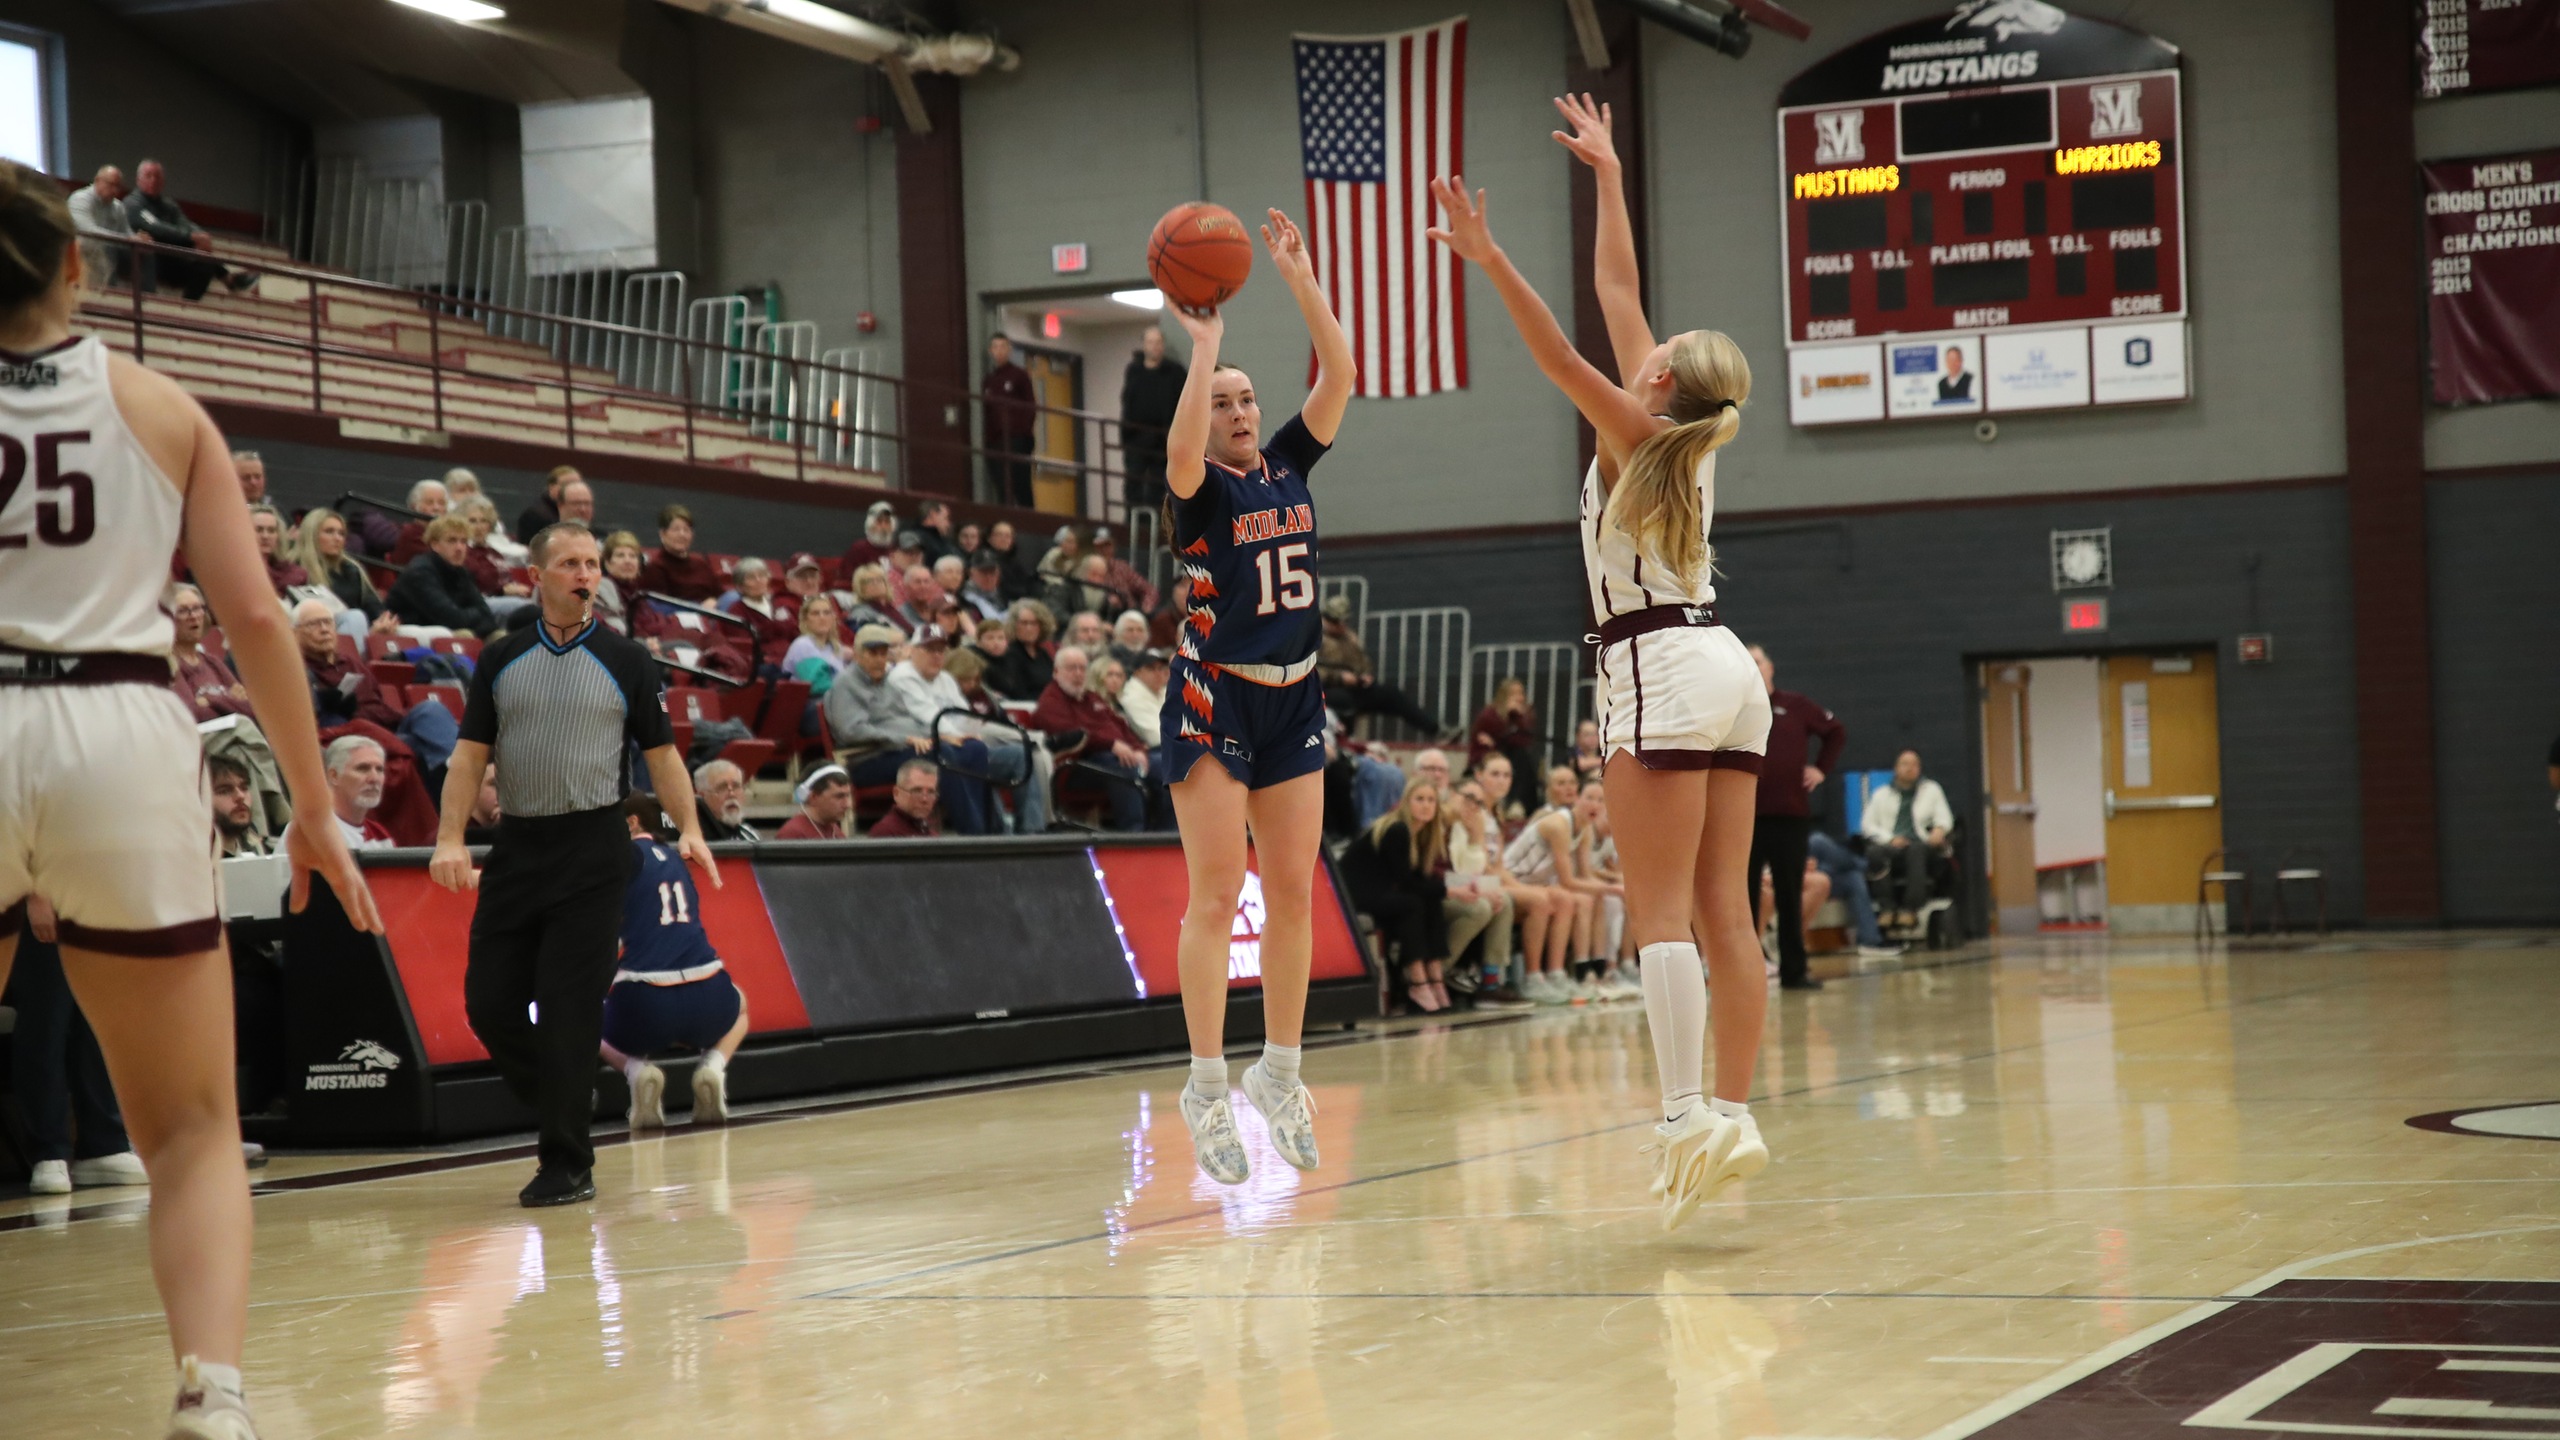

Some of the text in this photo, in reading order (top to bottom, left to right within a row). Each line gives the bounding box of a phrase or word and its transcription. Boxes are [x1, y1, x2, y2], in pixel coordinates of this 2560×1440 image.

[1889, 37, 1988, 60] MORNINGSIDE
[1881, 50, 2039, 91] MUSTANGS
[2429, 51, 2469, 72] 2017
[2055, 140, 2162, 175] WARRIORS
[1794, 165, 1900, 200] MUSTANGS
[1950, 168, 2005, 190] PERIOD
[2472, 160, 2533, 189] MEN'S
[2426, 189, 2486, 215] CROSS
[2049, 234, 2093, 254] T.O.L.
[2109, 227, 2162, 249] FOULS
[1870, 250, 1913, 270] T.O.L.
[1930, 239, 2034, 264] PLAYER FOUL
[1804, 253, 1854, 275] FOULS
[2432, 255, 2471, 277] 2013
[2433, 274, 2472, 295] 2014
[2110, 294, 2163, 316] SCORE
[1953, 307, 2009, 328] MATCH
[1806, 319, 1856, 340] SCORE
[1255, 541, 1315, 617] 15
[658, 880, 690, 926] 11
[308, 1063, 361, 1073] MORNINGSIDE
[304, 1073, 388, 1091] MUSTANGS
